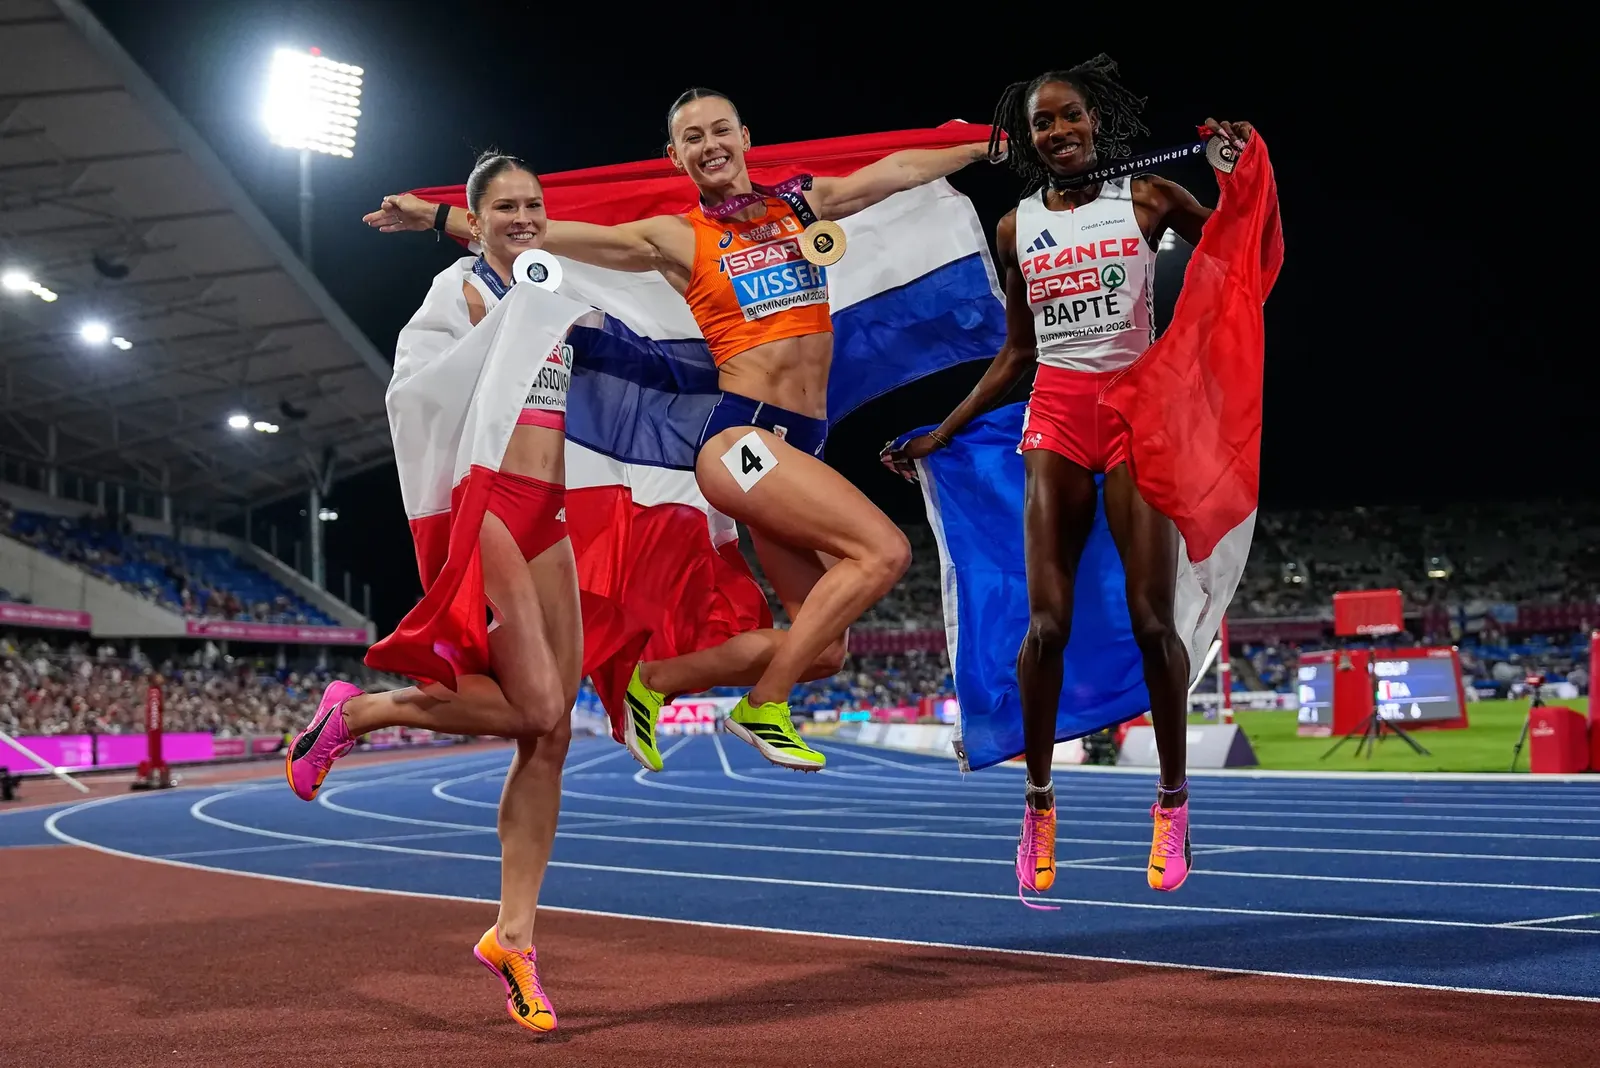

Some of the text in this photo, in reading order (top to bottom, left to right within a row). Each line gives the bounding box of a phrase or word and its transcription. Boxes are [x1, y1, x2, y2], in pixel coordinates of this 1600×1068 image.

[1119, 148, 1188, 172] BIRMINGHAM
[729, 241, 800, 273] SPAR
[1021, 237, 1140, 280] FRANCE
[740, 265, 823, 300] VISSER
[1031, 271, 1098, 300] SPAR
[746, 292, 811, 316] BIRMINGHAM
[1042, 287, 1121, 327] BAPTÉ
[1040, 320, 1132, 343] BIRMINGHAM 2026
[741, 444, 764, 475] 4
[658, 704, 716, 724] PAR
